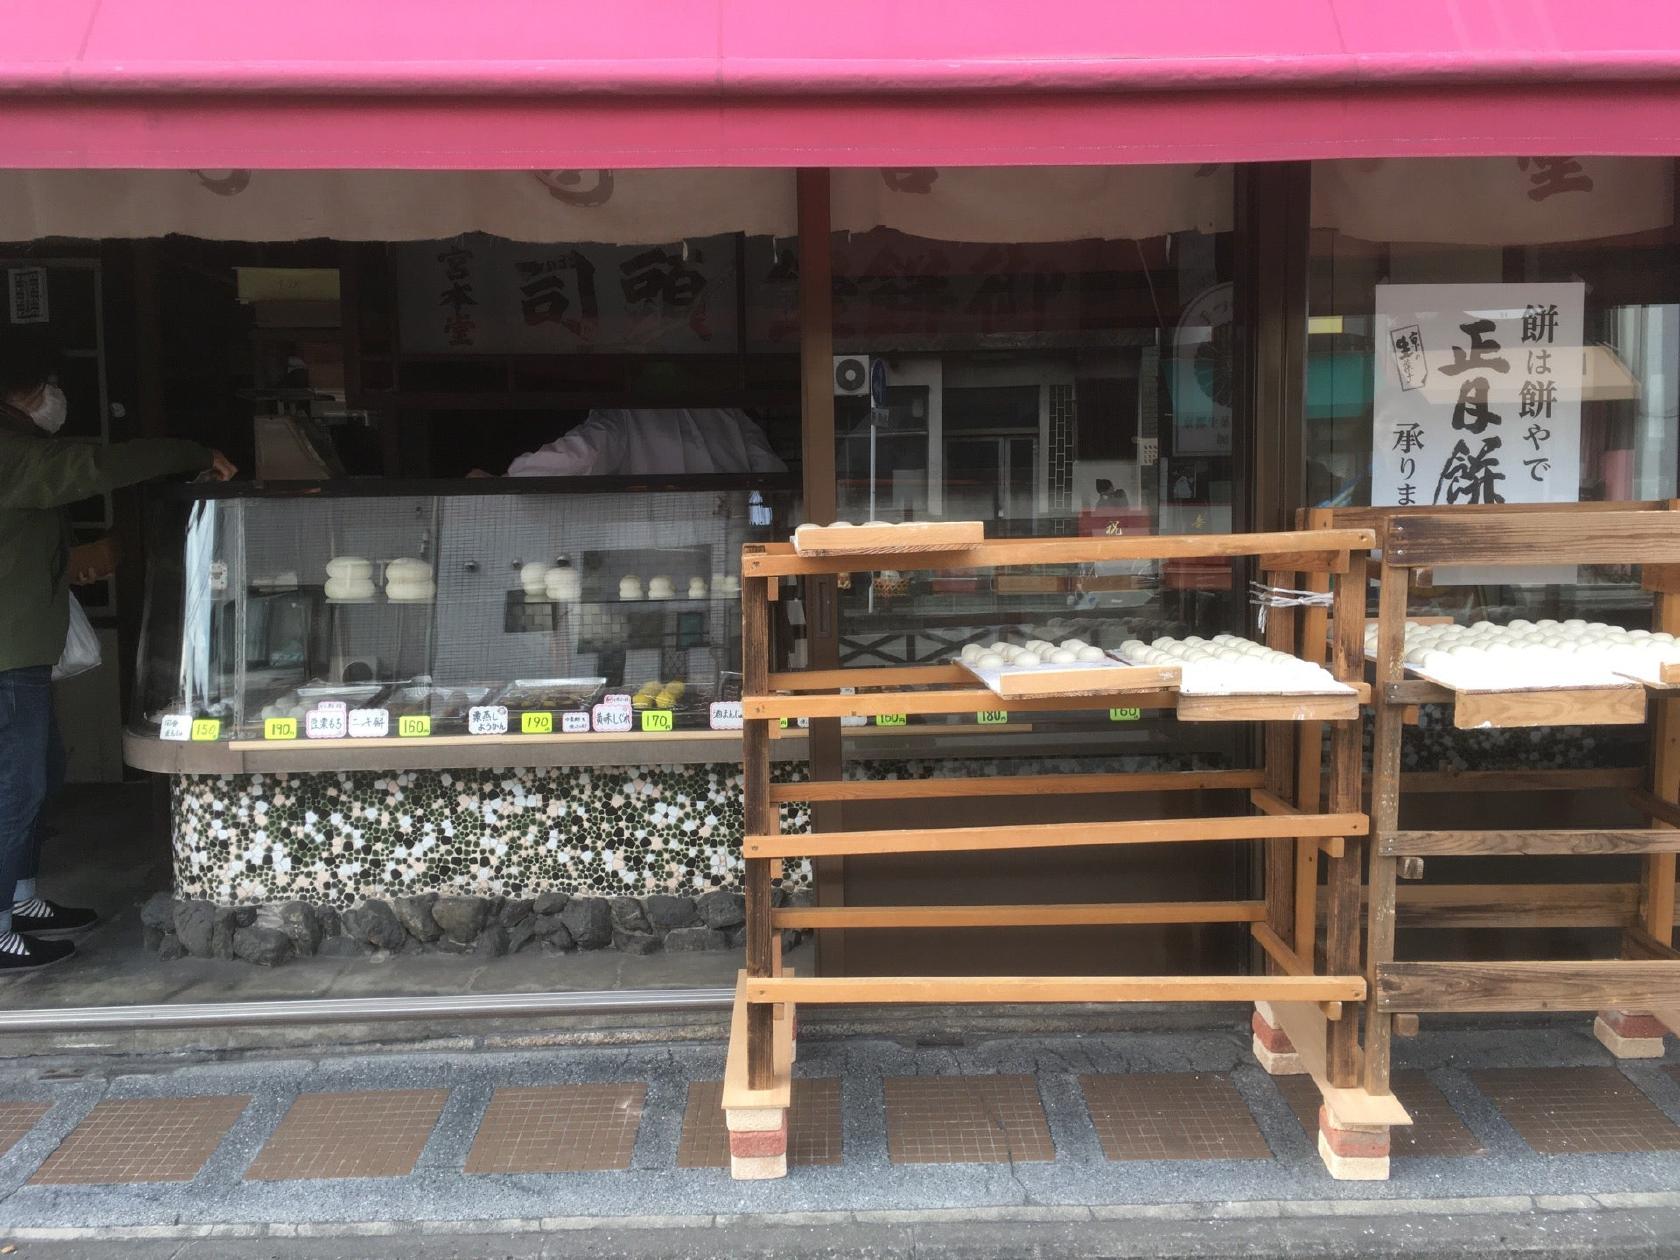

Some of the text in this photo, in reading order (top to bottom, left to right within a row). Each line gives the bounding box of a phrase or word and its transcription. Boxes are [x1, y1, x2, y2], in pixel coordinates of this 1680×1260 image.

[1392, 422, 1425, 505] 承りま
[1433, 319, 1511, 504] 正月餅
[1519, 304, 1560, 482] 餅は餅やで
